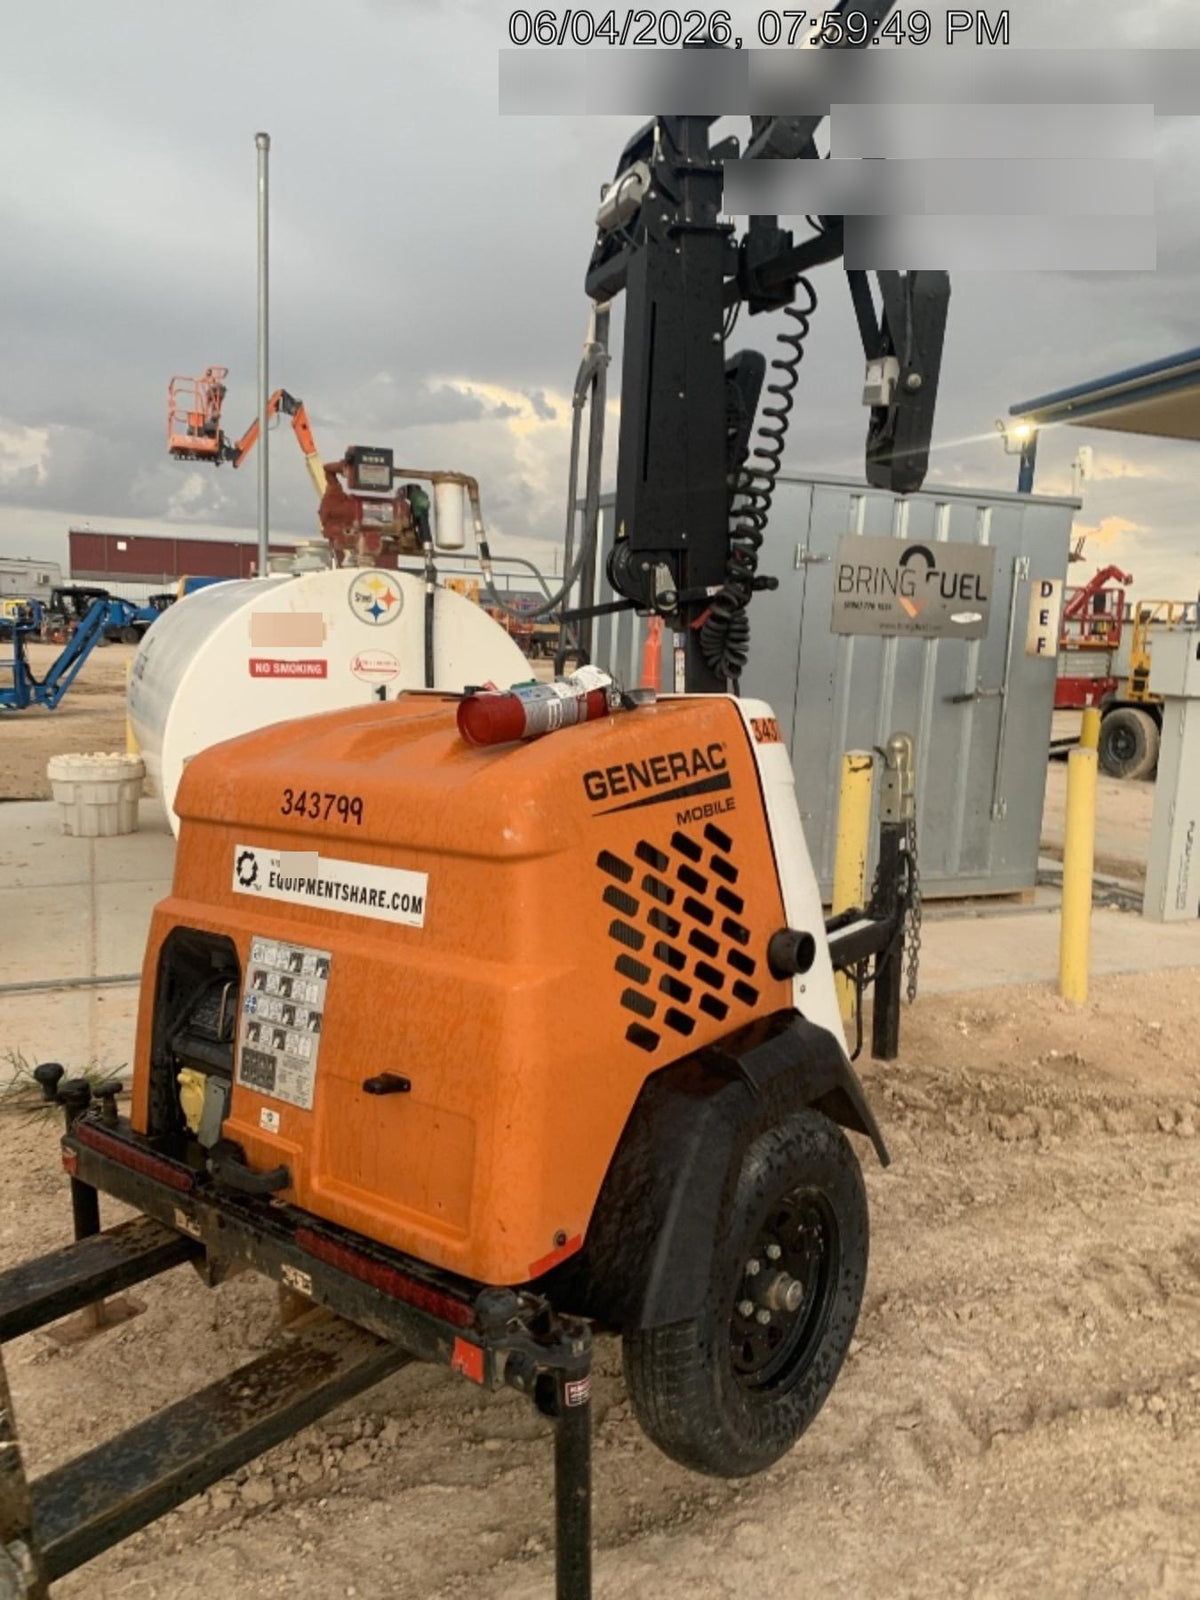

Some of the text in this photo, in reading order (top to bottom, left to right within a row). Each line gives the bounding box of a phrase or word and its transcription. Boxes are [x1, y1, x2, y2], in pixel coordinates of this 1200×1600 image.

[837, 563, 916, 598] BRING
[255, 662, 323, 675] NO SMOKING
[749, 717, 782, 743] 343
[582, 743, 727, 802] GENERAC
[280, 788, 364, 826] 343799
[675, 796, 736, 826] MOBILE
[268, 871, 424, 915] EQUIPMENTSHARE.COM
